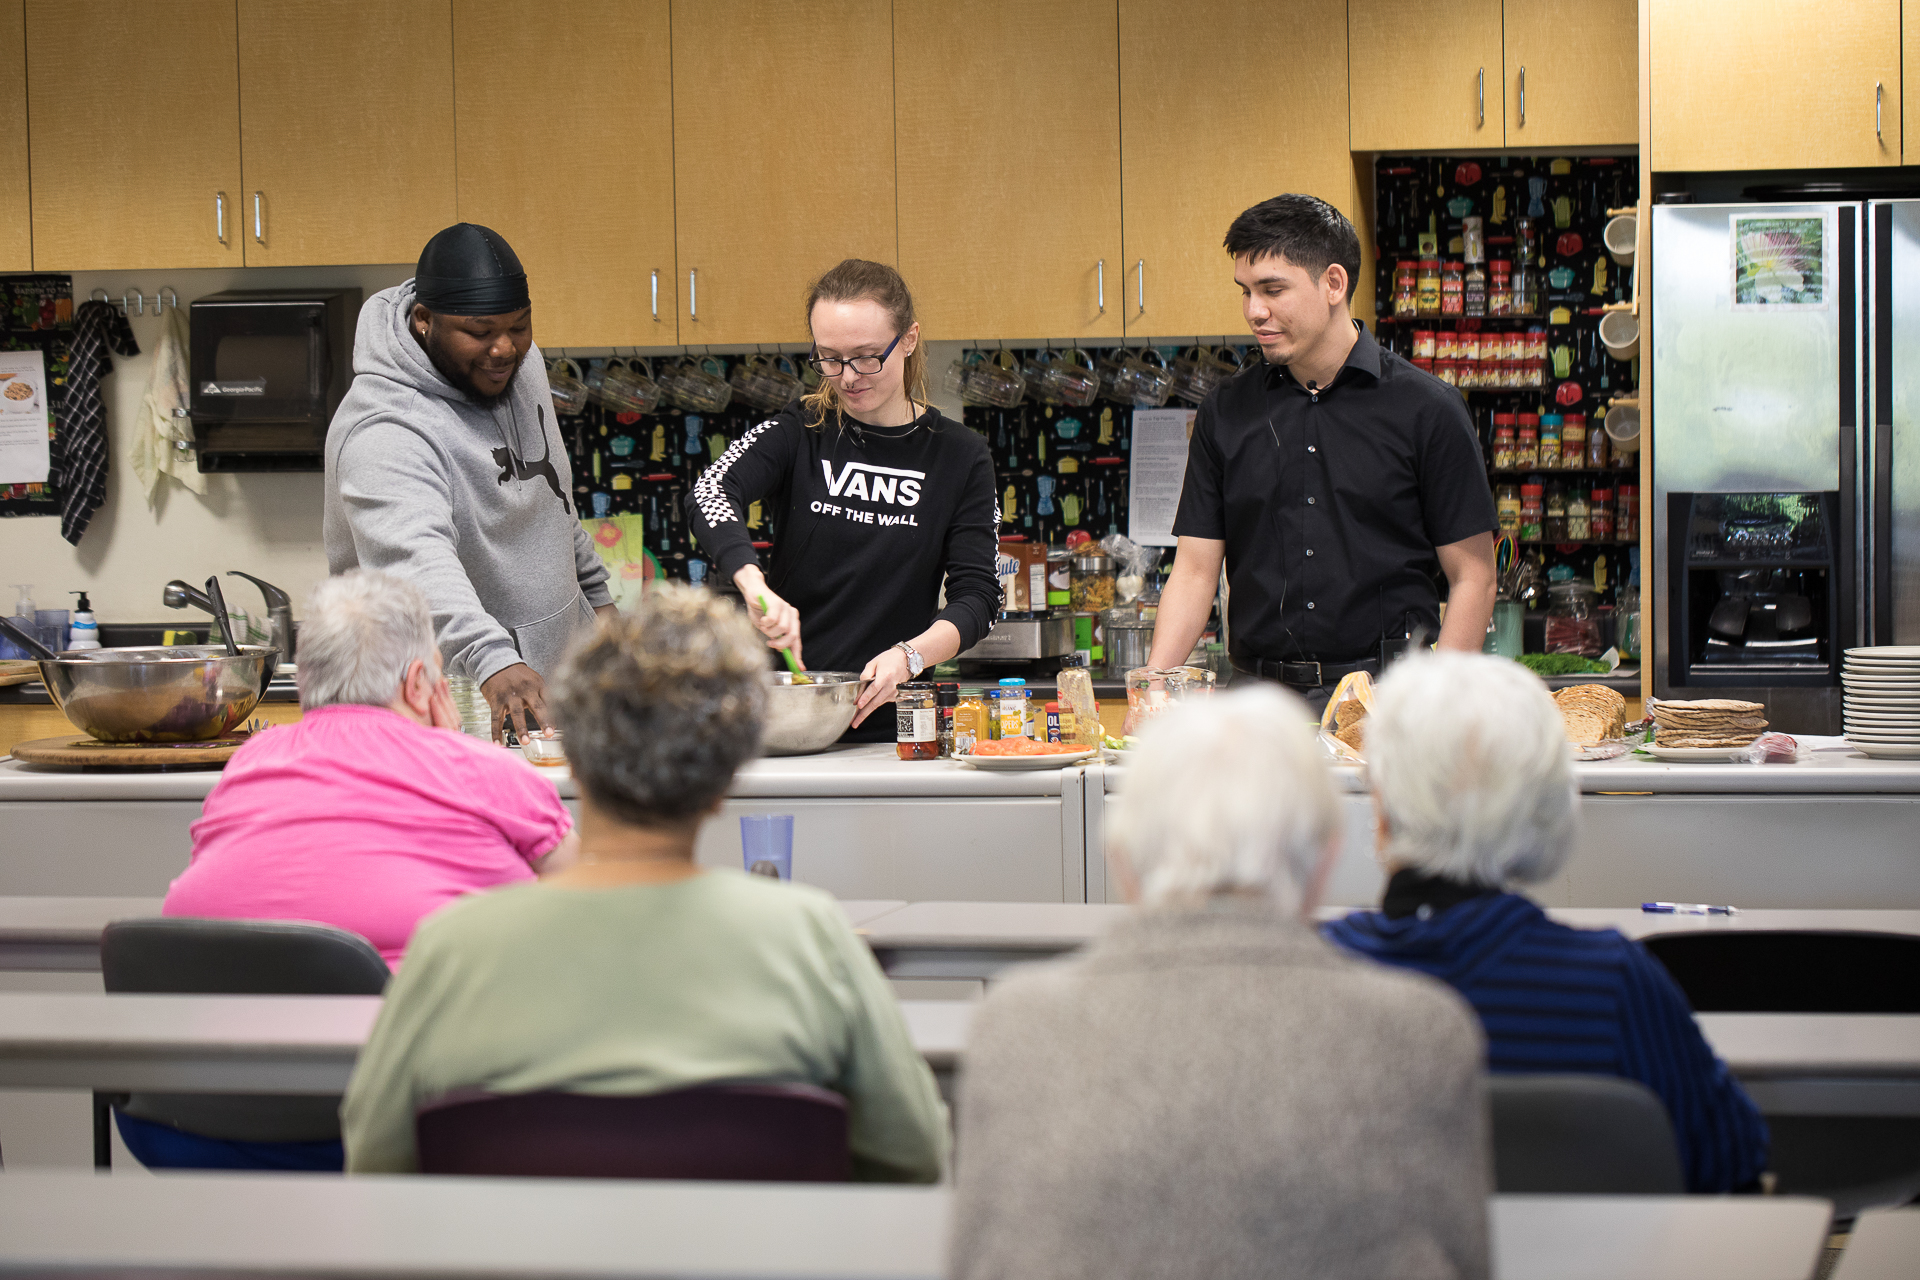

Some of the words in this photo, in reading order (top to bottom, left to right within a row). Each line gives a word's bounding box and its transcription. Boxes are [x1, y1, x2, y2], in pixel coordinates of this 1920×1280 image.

[821, 459, 926, 507] VANS
[810, 501, 842, 516] OFF
[845, 508, 875, 524] THE
[877, 513, 919, 527] WALL
